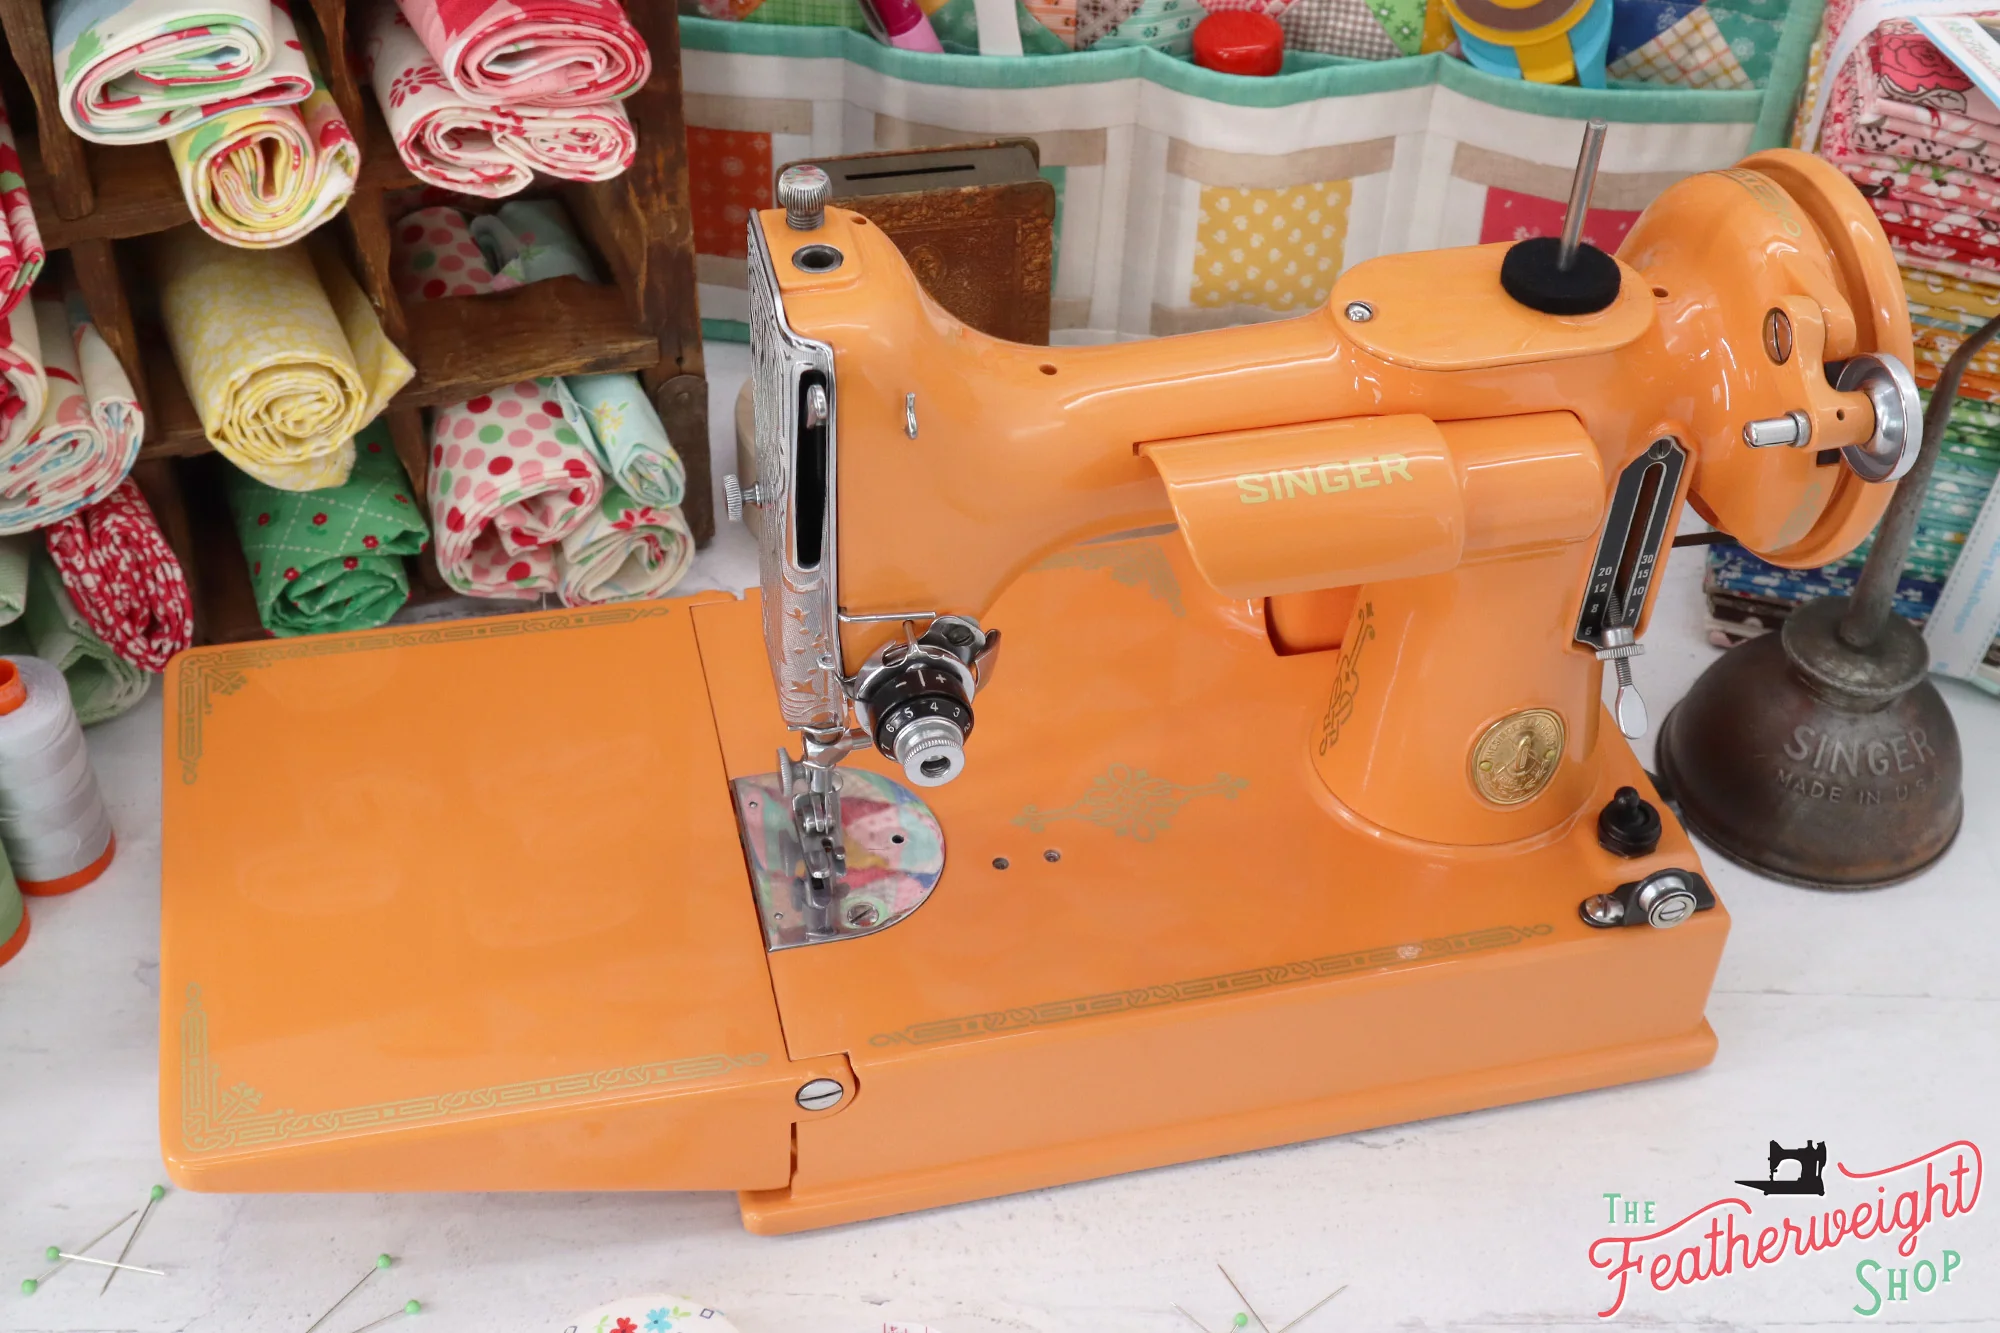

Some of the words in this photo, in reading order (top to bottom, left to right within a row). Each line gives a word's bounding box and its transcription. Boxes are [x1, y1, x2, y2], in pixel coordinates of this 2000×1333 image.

[1236, 453, 1413, 504] SINGER
[1641, 554, 1654, 565] 30
[1597, 566, 1613, 577] 20
[1637, 568, 1650, 579] 15
[1593, 582, 1608, 594] 12
[1632, 586, 1645, 596] 10
[1590, 603, 1600, 613] 8
[1628, 608, 1635, 618] 7
[1584, 626, 1593, 636] 6
[885, 723, 895, 733] 6
[904, 706, 914, 719] 5
[930, 701, 939, 712] 4
[952, 706, 961, 718] 3
[1783, 725, 1936, 777] SINGER
[1776, 768, 1843, 804] MADE
[1859, 790, 1881, 806] IN
